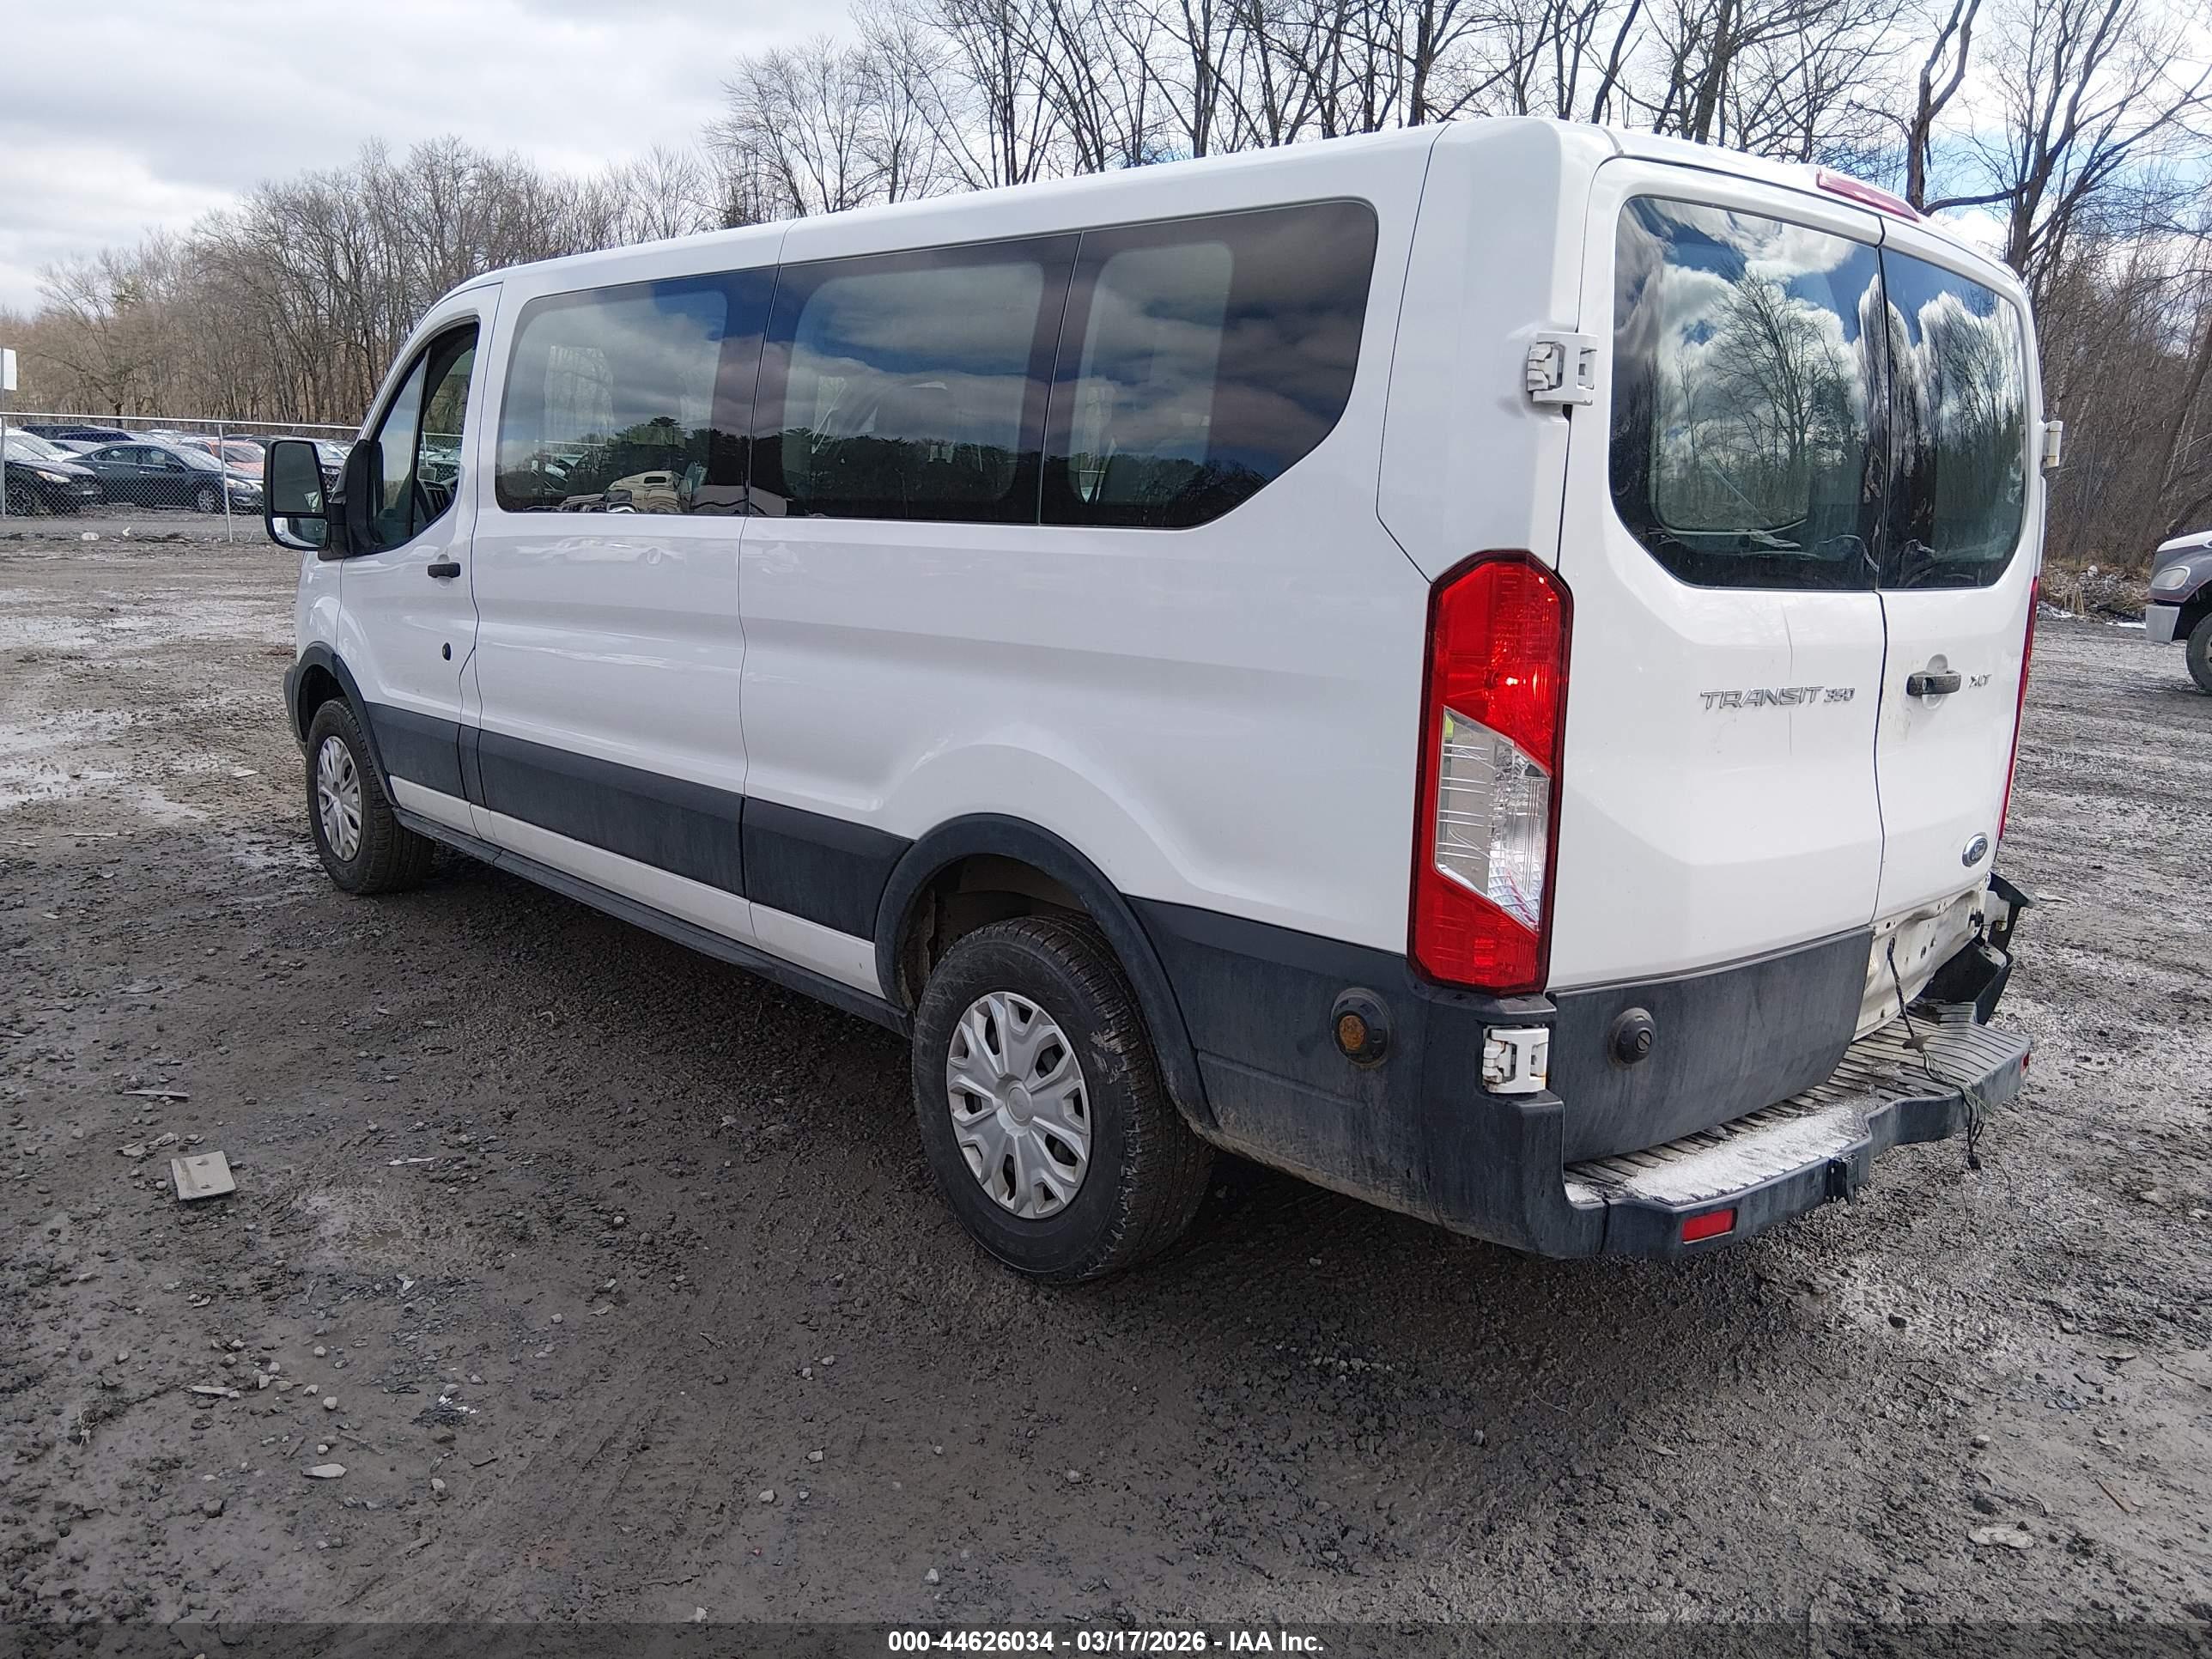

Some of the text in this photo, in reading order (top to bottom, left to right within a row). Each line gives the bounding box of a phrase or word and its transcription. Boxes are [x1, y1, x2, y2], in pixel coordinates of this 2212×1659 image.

[1967, 673, 1993, 689] XLT
[1700, 686, 1856, 710] TRANSIT 350
